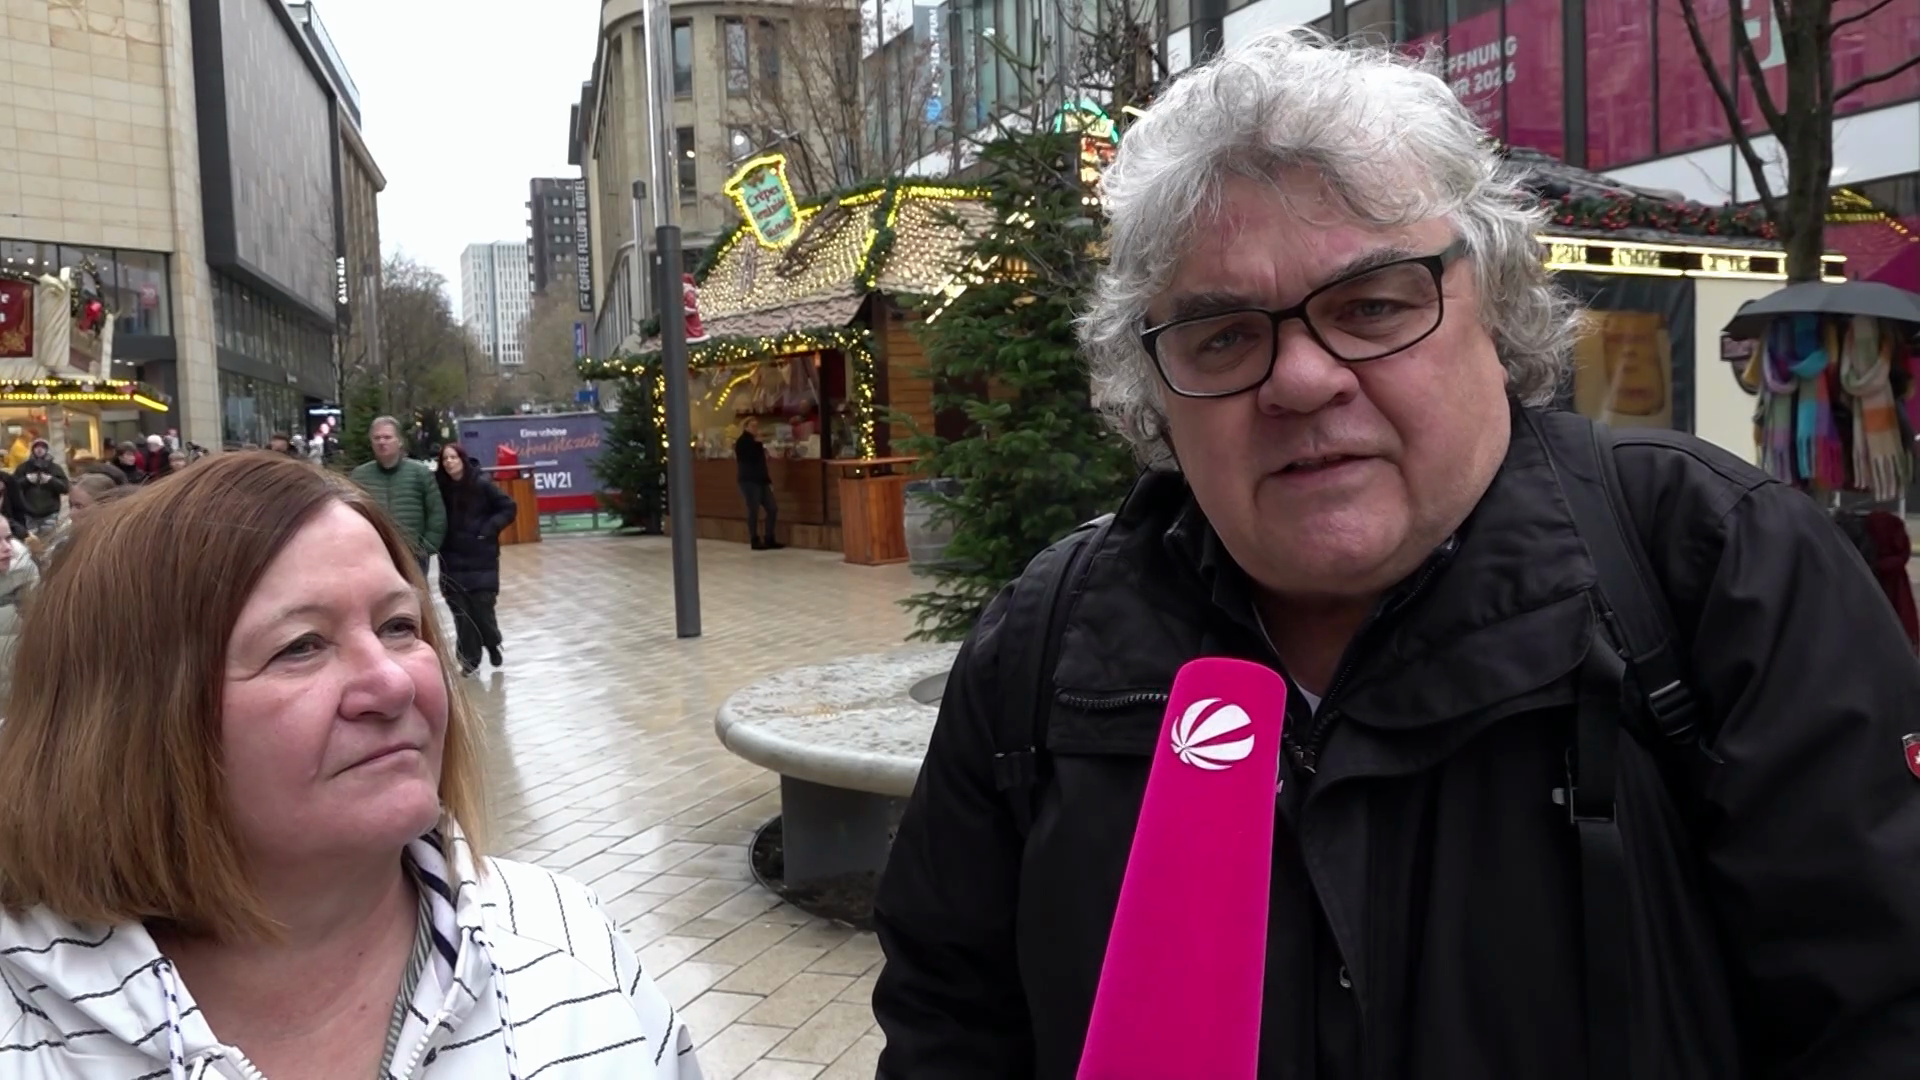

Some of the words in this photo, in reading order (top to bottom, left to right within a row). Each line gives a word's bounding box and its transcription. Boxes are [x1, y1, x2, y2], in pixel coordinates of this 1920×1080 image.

[1474, 61, 1516, 93] 2026
[574, 179, 587, 209] HOTEL
[576, 210, 589, 254] FELLOWS
[577, 255, 591, 292] COFFEE
[533, 471, 573, 490] EW21
